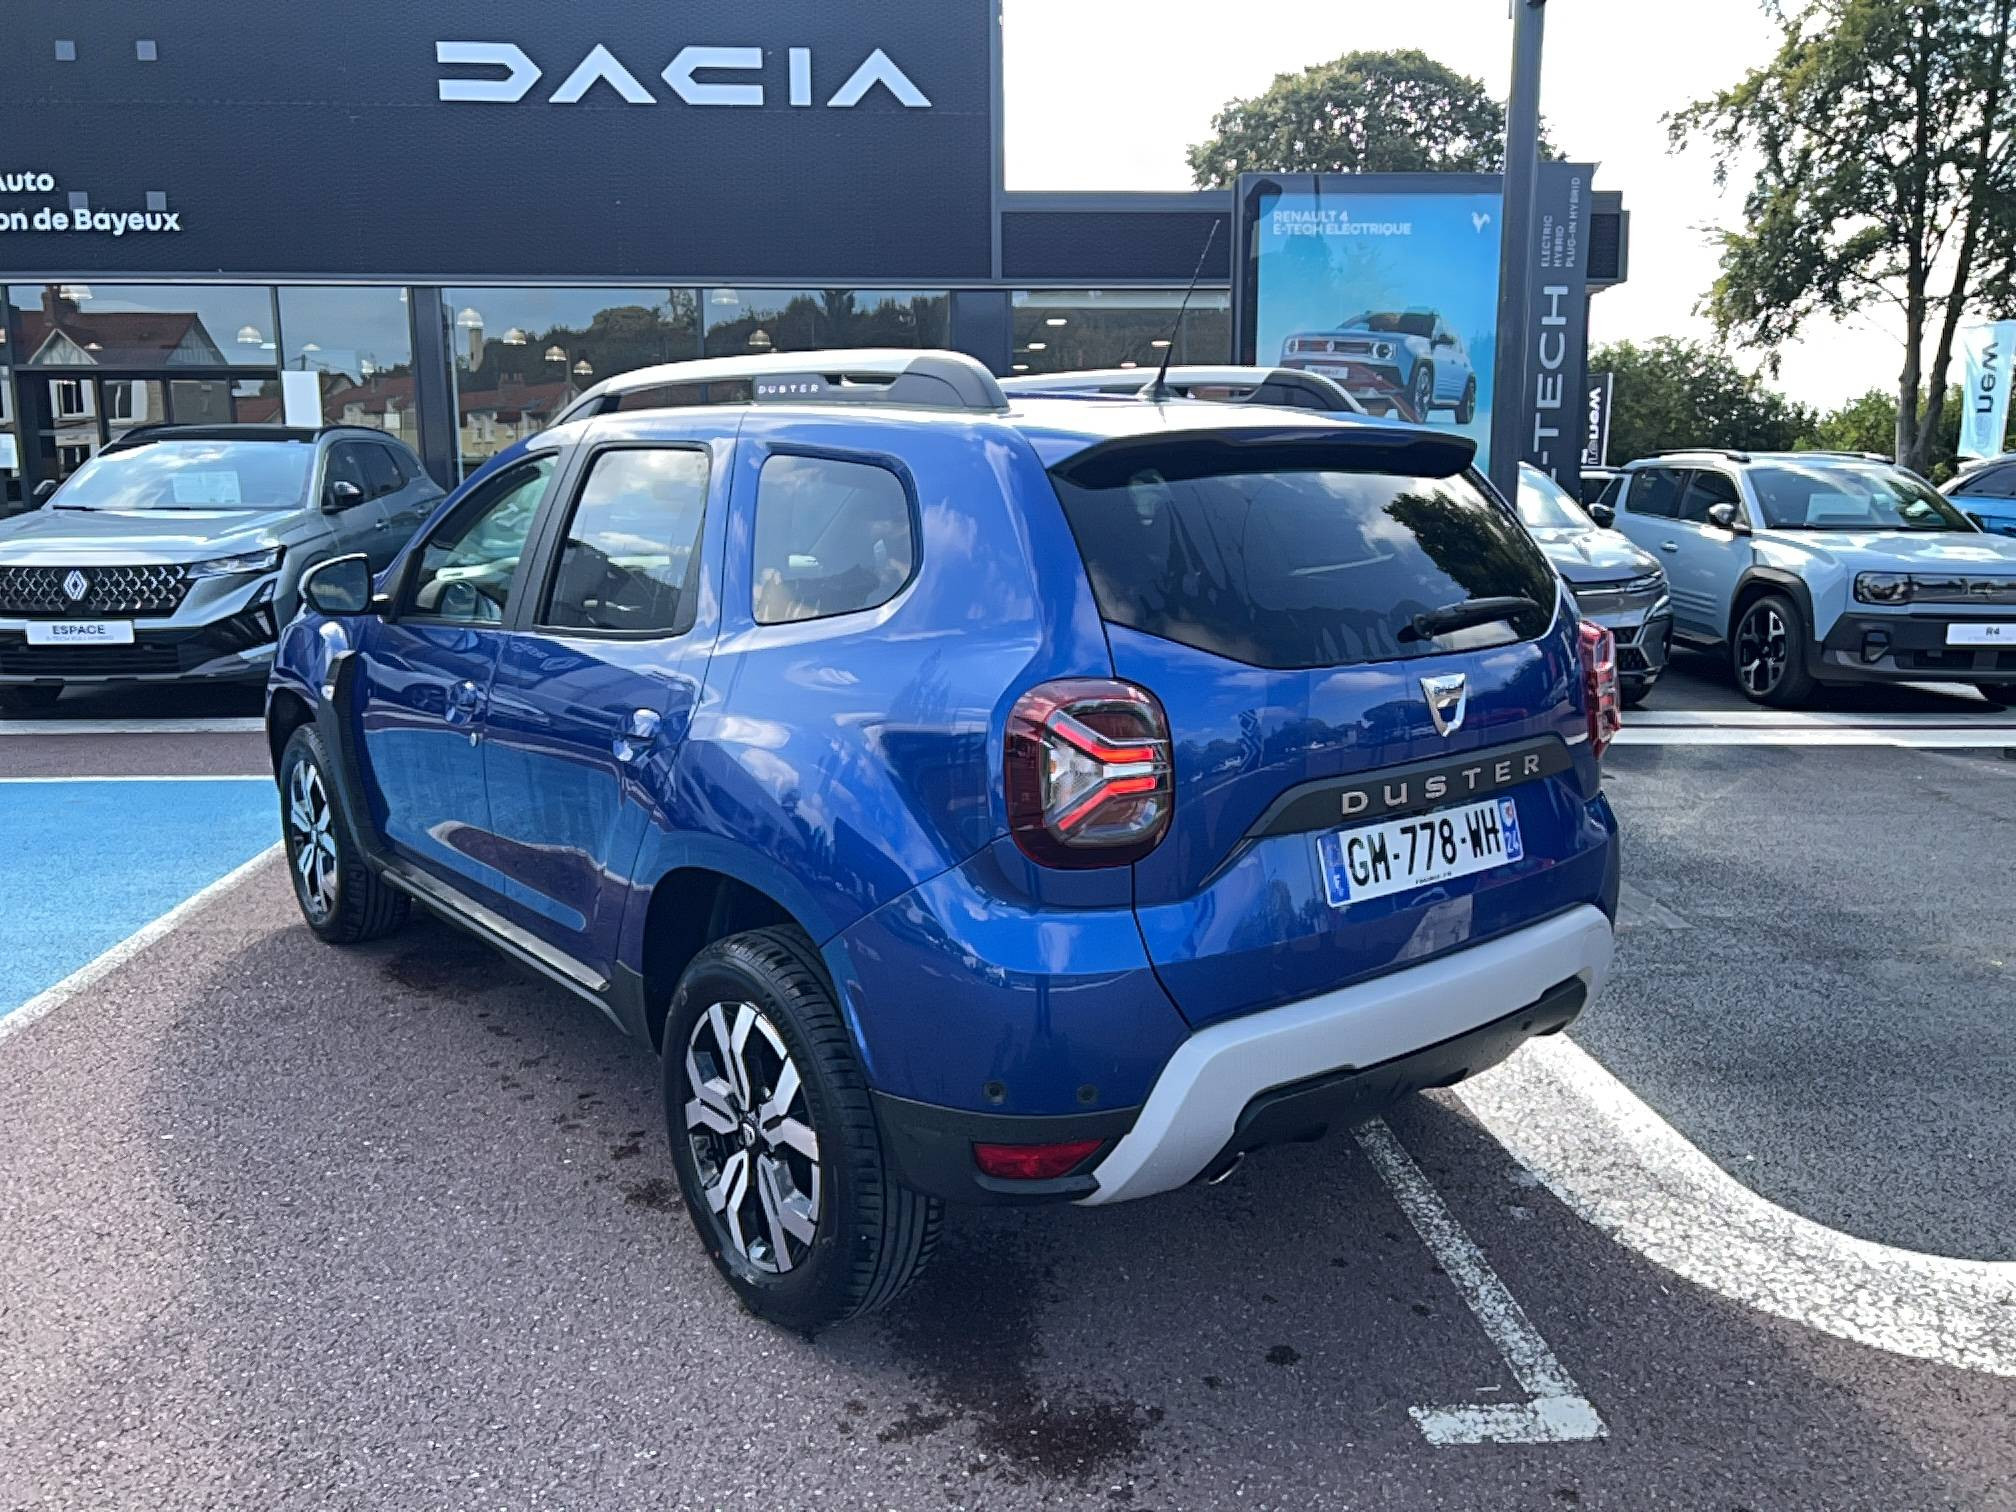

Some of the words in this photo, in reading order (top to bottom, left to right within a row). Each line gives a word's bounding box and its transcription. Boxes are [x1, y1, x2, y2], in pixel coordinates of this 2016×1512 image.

[435, 41, 932, 107] DACIA
[1272, 210, 1336, 223] RENAULT
[1339, 210, 1349, 223] 4
[1569, 177, 1581, 219] HYBRID
[33, 207, 69, 231] de
[74, 208, 181, 236] Bayeux
[1272, 223, 1323, 236] E-TECH
[1541, 215, 1553, 267] ELECTRIC
[1553, 225, 1565, 267] HYBRID
[1565, 221, 1577, 267] PLUG-IN
[1533, 286, 1569, 482] -TECH
[52, 625, 106, 635] ESPACE
[1986, 627, 2000, 635] R4
[1341, 754, 1540, 815] DUSTER
[1347, 807, 1501, 887] GM-778-WH
